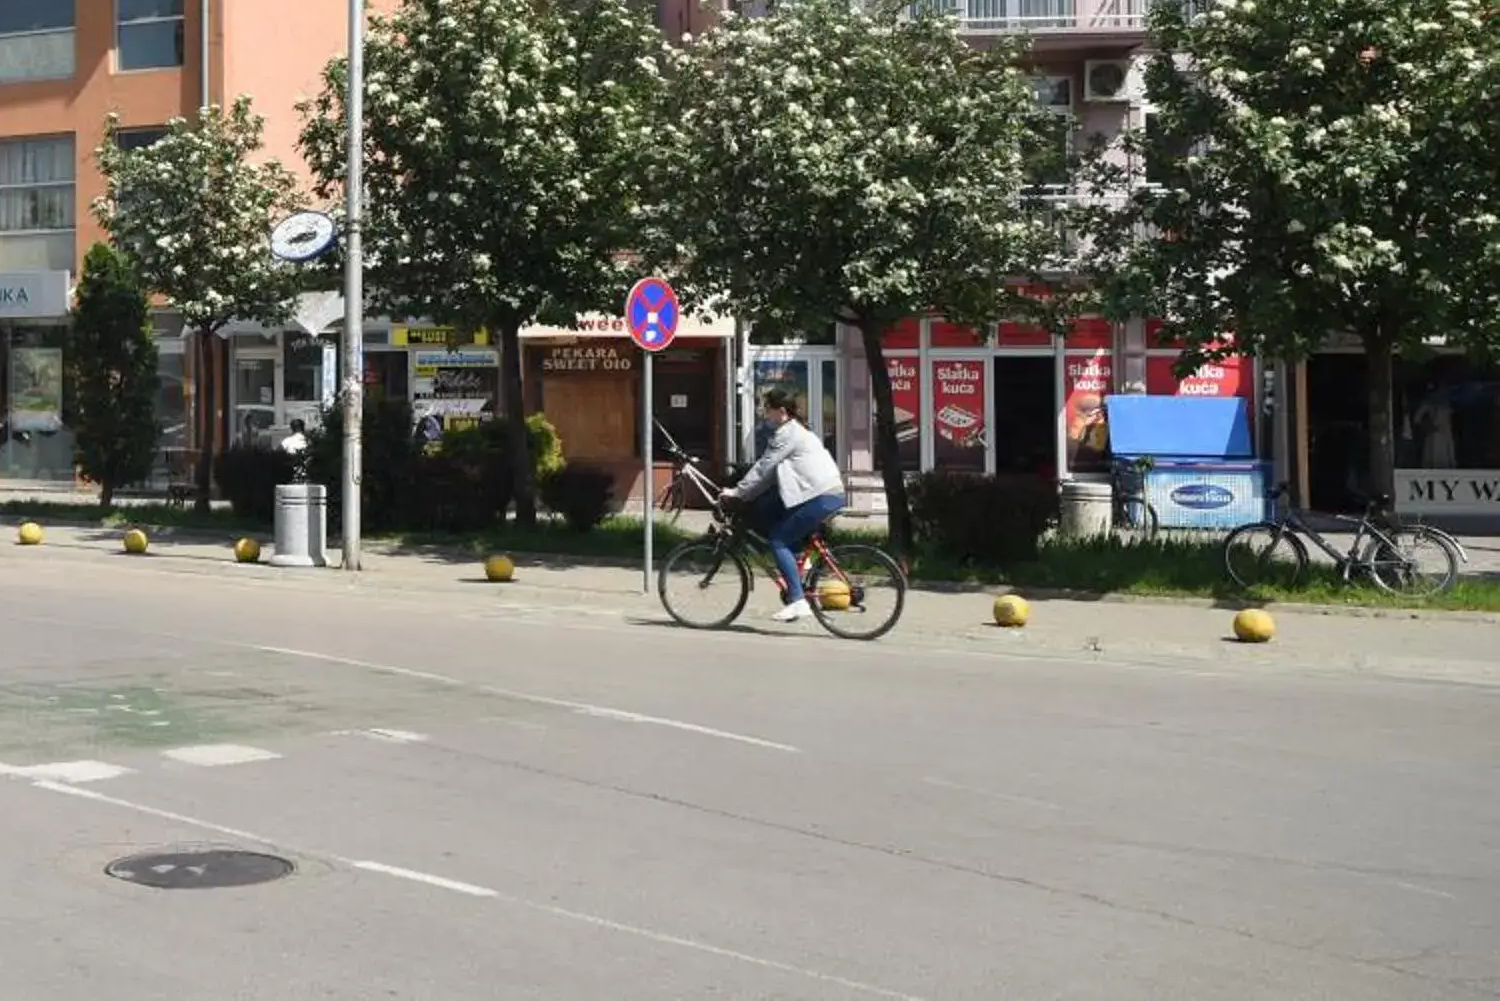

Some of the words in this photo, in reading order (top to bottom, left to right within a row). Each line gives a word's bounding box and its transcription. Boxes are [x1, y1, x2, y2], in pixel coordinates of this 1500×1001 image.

[552, 347, 617, 358] PEKARA
[543, 358, 597, 370] SWEET
[937, 367, 979, 380] Slatka
[1408, 480, 1460, 501] MY
[1468, 480, 1500, 501] W
